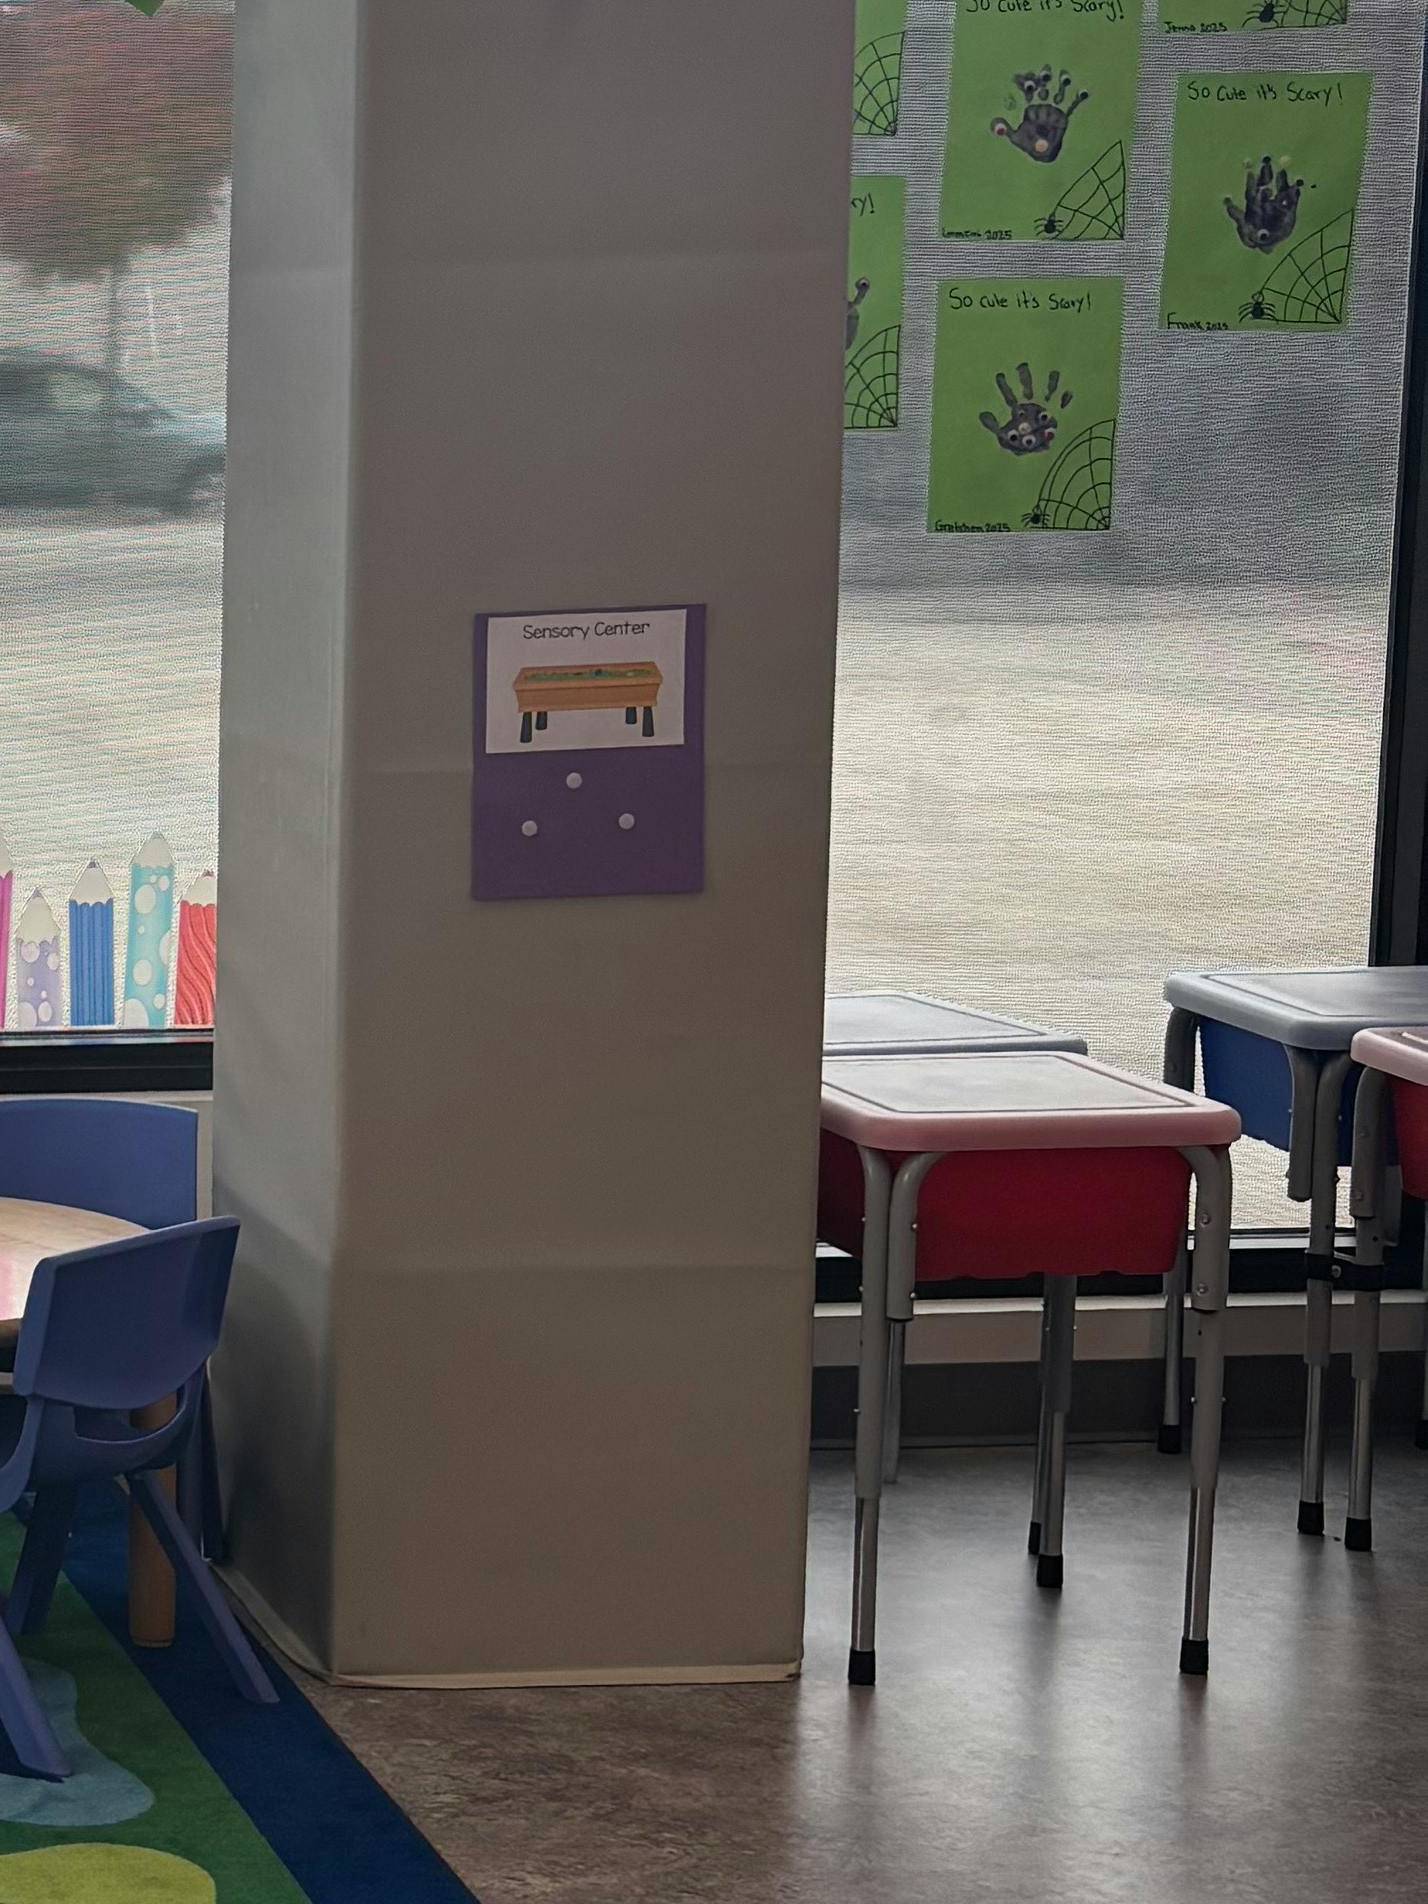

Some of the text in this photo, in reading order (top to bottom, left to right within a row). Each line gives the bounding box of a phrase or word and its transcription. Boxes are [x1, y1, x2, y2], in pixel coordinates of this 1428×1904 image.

[1187, 81, 1210, 101] So
[1286, 81, 1343, 107] Scary!
[949, 287, 973, 309] So
[523, 620, 650, 641] Sensory Center
